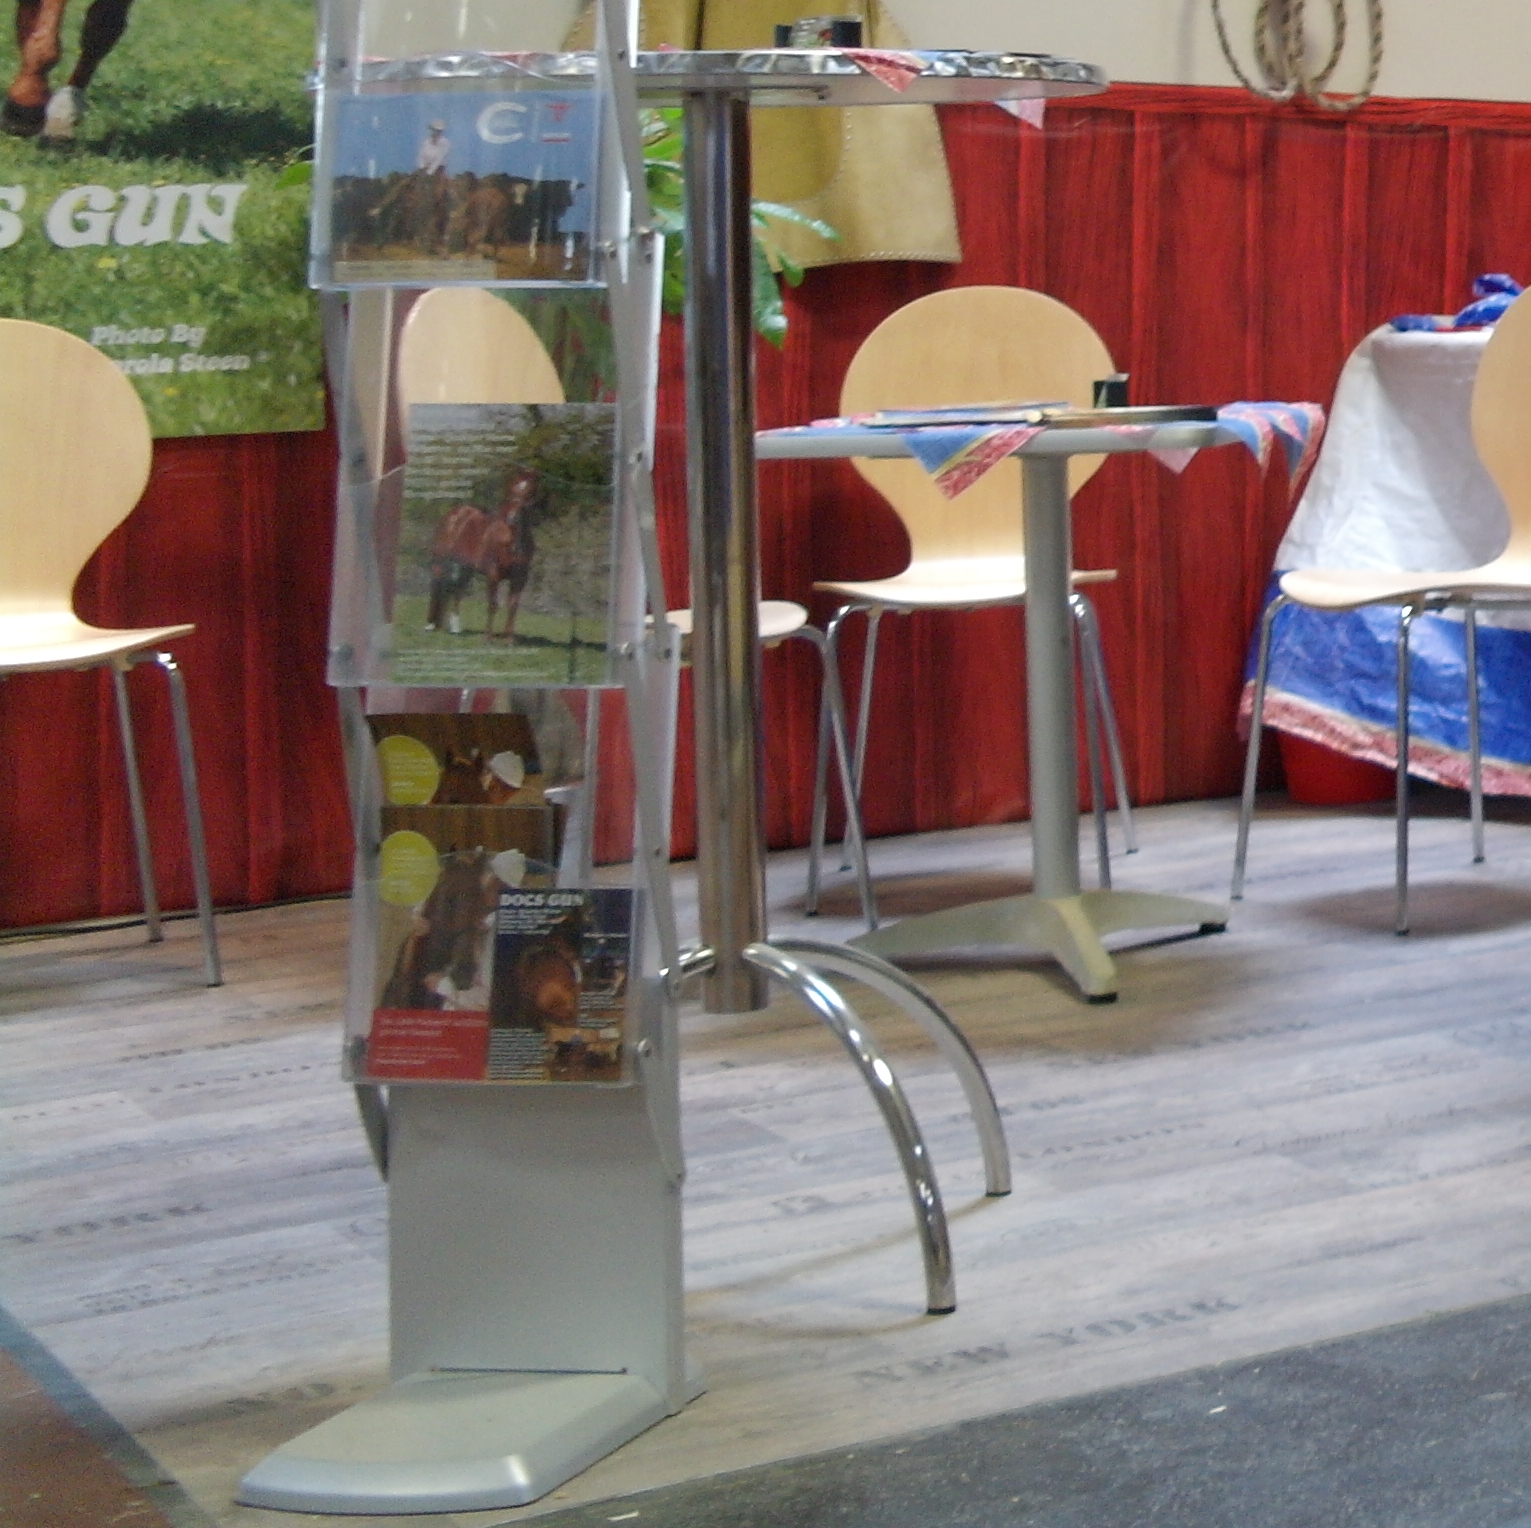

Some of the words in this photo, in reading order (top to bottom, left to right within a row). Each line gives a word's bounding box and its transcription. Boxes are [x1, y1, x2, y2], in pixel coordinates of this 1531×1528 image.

[46, 184, 248, 249] GUN
[90, 324, 167, 347] Photo
[169, 324, 208, 349] By
[499, 893, 546, 906] DOCS
